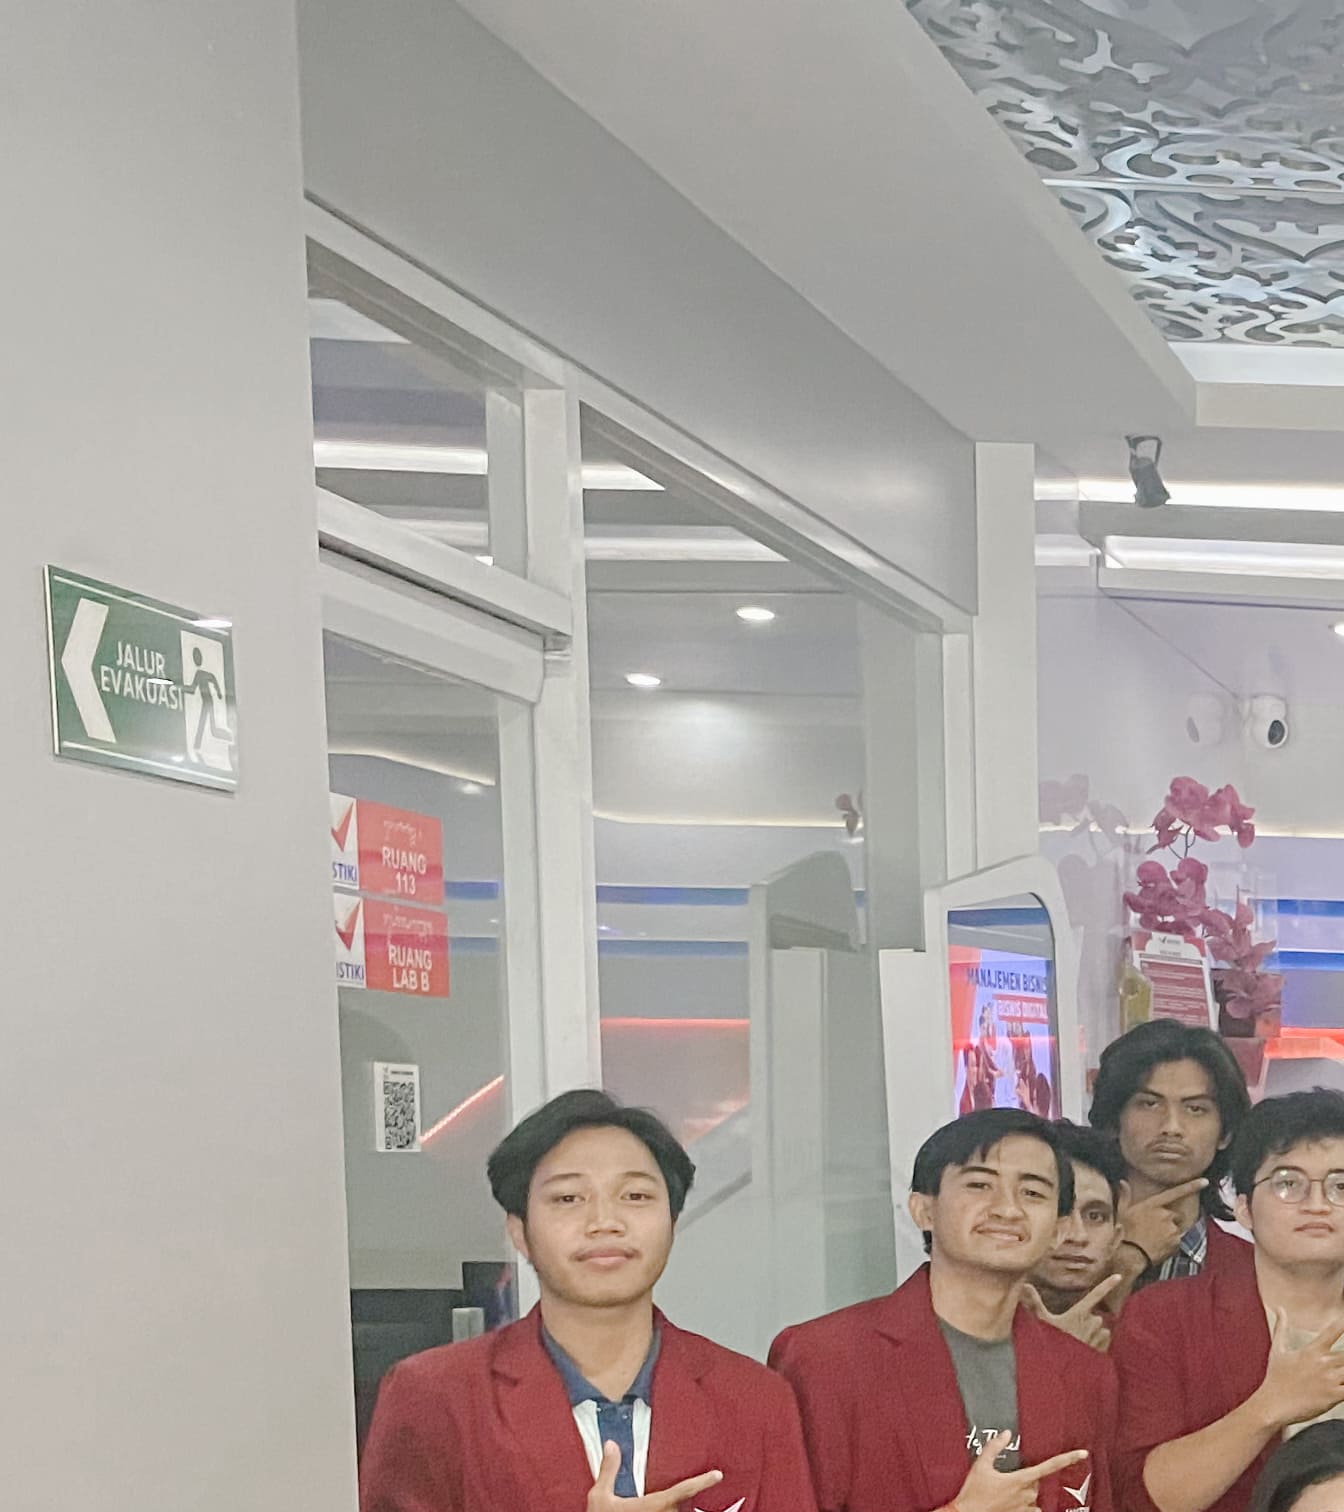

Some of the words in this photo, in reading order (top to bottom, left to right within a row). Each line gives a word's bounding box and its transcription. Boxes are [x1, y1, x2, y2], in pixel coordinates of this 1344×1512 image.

[116, 641, 165, 678] JALUR
[100, 665, 183, 711] EVAKUASI
[332, 862, 358, 882] STIKI
[382, 846, 428, 875] RUANG
[395, 871, 416, 895] 113
[387, 944, 433, 971] RUANG
[335, 962, 365, 981] STIKI
[392, 967, 418, 990] LAB
[420, 971, 430, 992] B
[966, 967, 1021, 991] MANAJEMEN
